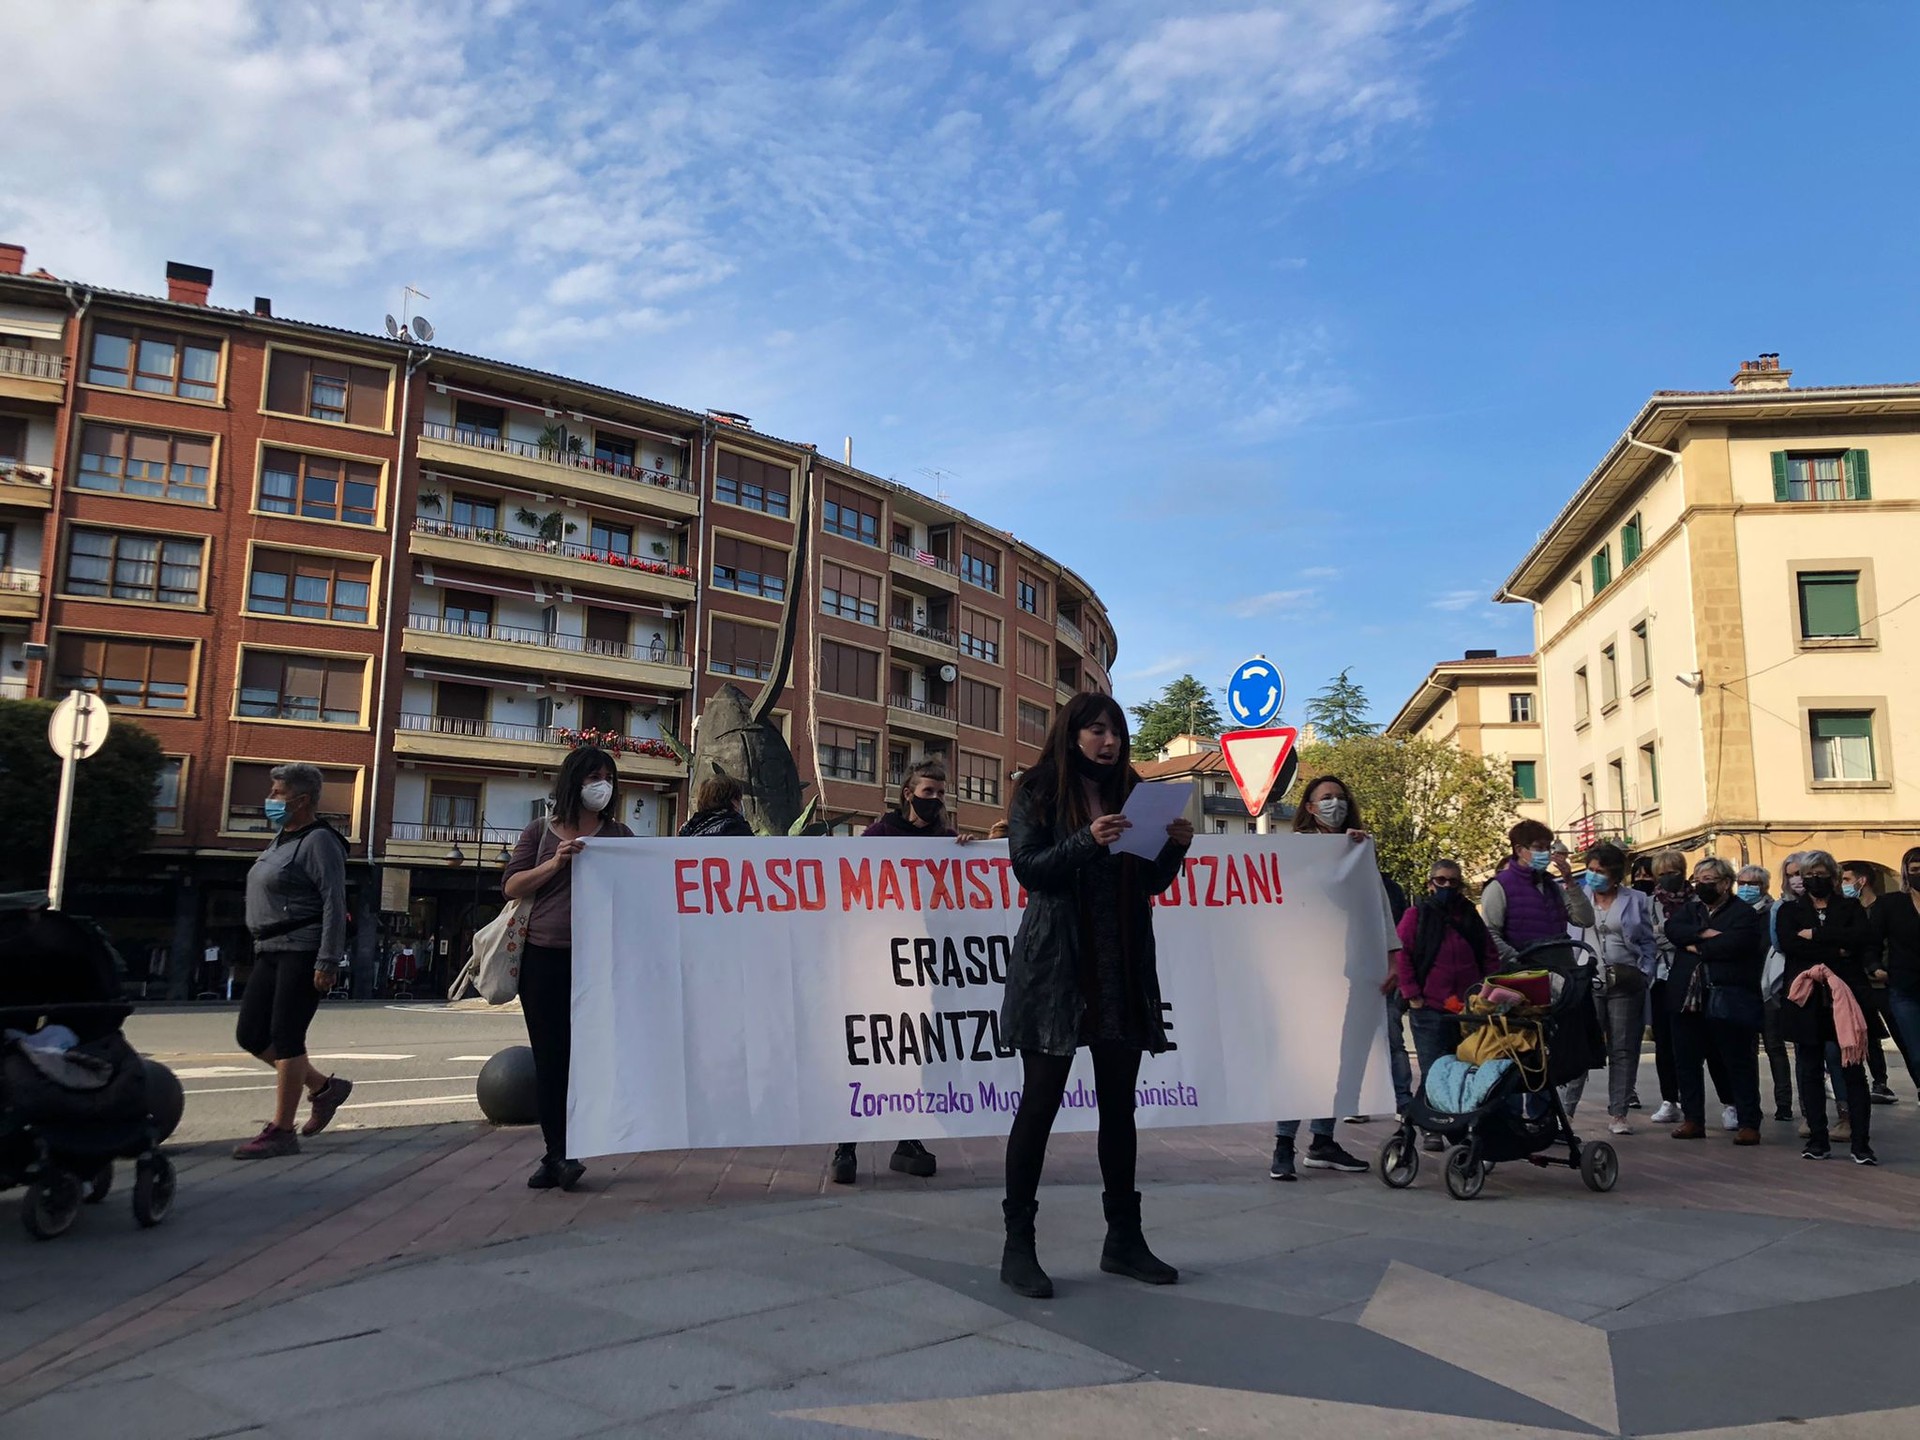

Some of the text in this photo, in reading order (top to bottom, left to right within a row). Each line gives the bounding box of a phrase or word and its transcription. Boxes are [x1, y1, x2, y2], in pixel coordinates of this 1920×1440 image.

[674, 857, 826, 914] ERASO
[839, 857, 1029, 912] MATXIST
[890, 936, 1017, 988] ERASO
[845, 1010, 1018, 1066] ERANTZU
[849, 1081, 974, 1118] Zornotzako
